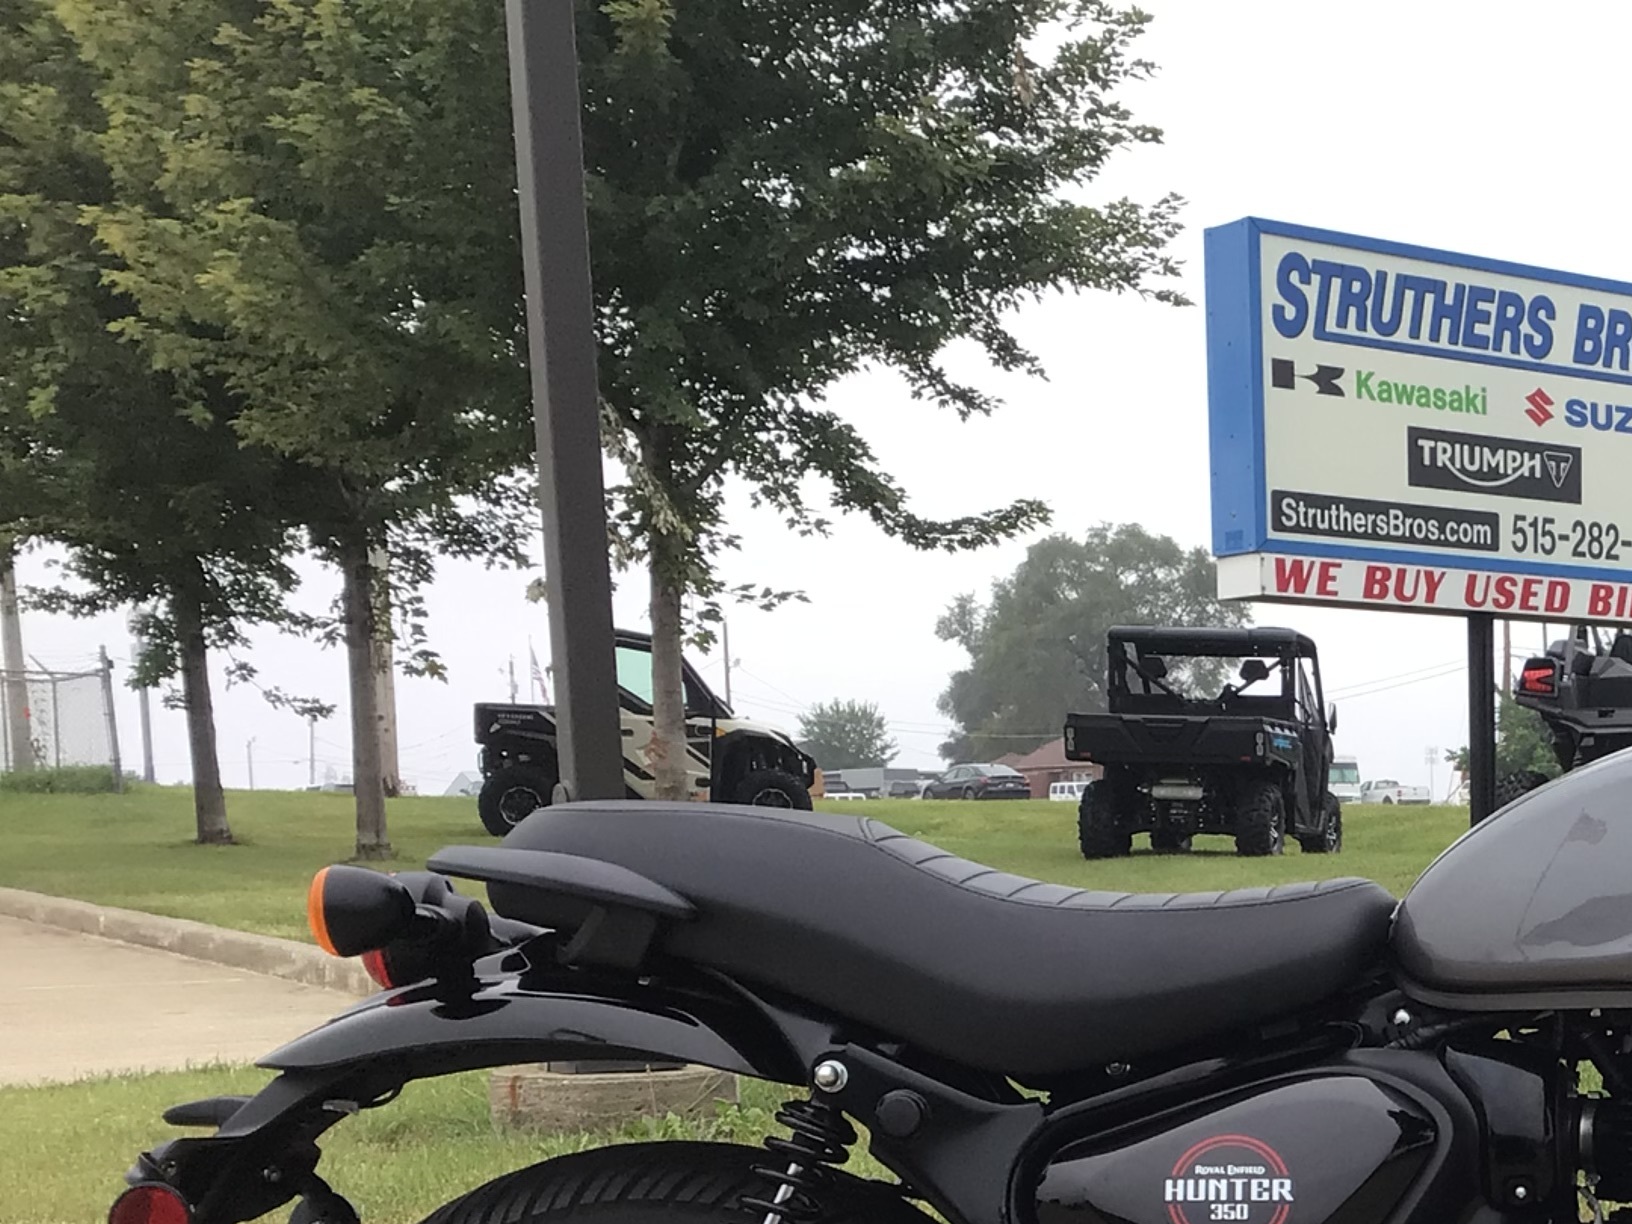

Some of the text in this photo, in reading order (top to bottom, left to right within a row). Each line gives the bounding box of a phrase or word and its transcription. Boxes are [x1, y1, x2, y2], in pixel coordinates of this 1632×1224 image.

[1272, 251, 1556, 360] STRUTHERS
[1355, 370, 1488, 415] Kawasaki
[1417, 438, 1541, 486] TRIUMPH
[1280, 496, 1493, 546] StruthersBros.com
[1274, 557, 1345, 597] WE
[1362, 565, 1447, 605] BUY
[1464, 573, 1572, 615] USED
[1164, 1178, 1294, 1202] HUNTER
[1209, 1203, 1250, 1220] 350
